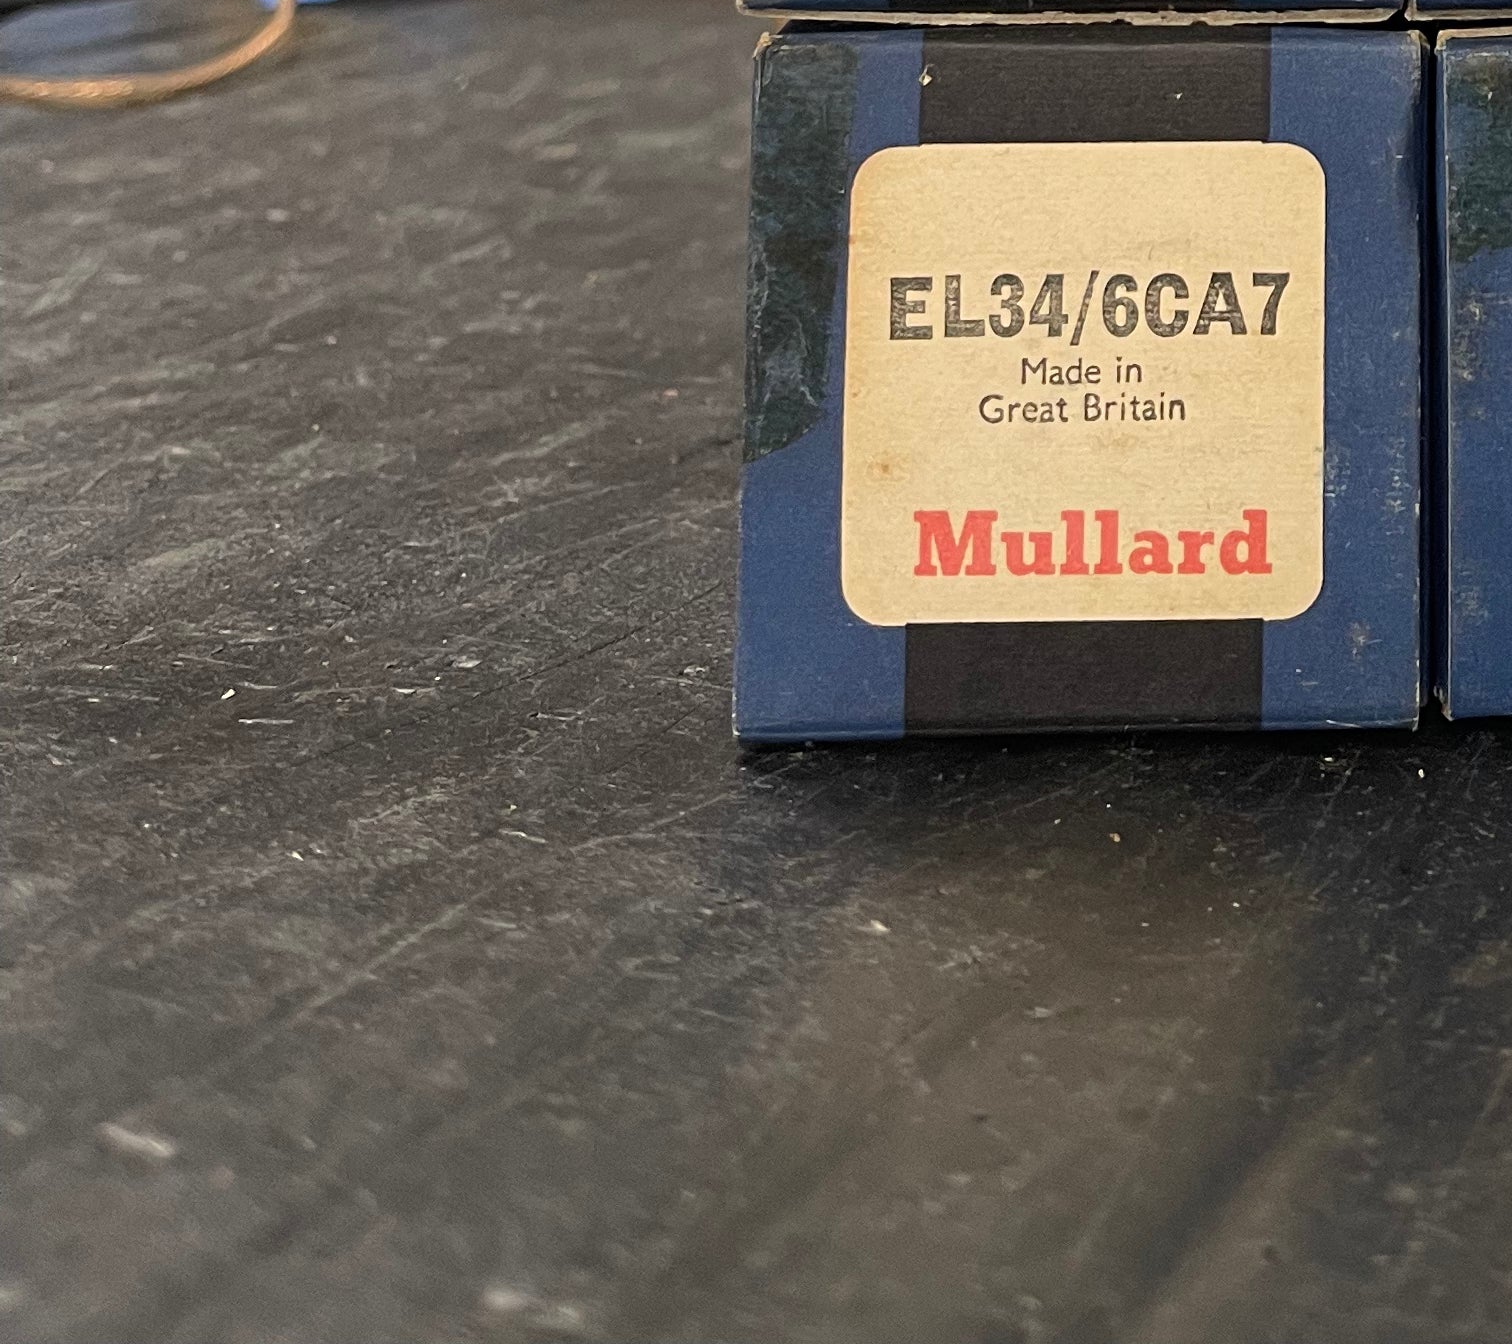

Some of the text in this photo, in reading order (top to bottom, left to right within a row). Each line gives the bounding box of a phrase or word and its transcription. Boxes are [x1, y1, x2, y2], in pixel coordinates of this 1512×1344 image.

[888, 269, 1291, 347] EL34/6CA7
[1020, 355, 1142, 386] Made in
[978, 391, 1186, 425] Great Britain
[912, 508, 1273, 578] Mullard
